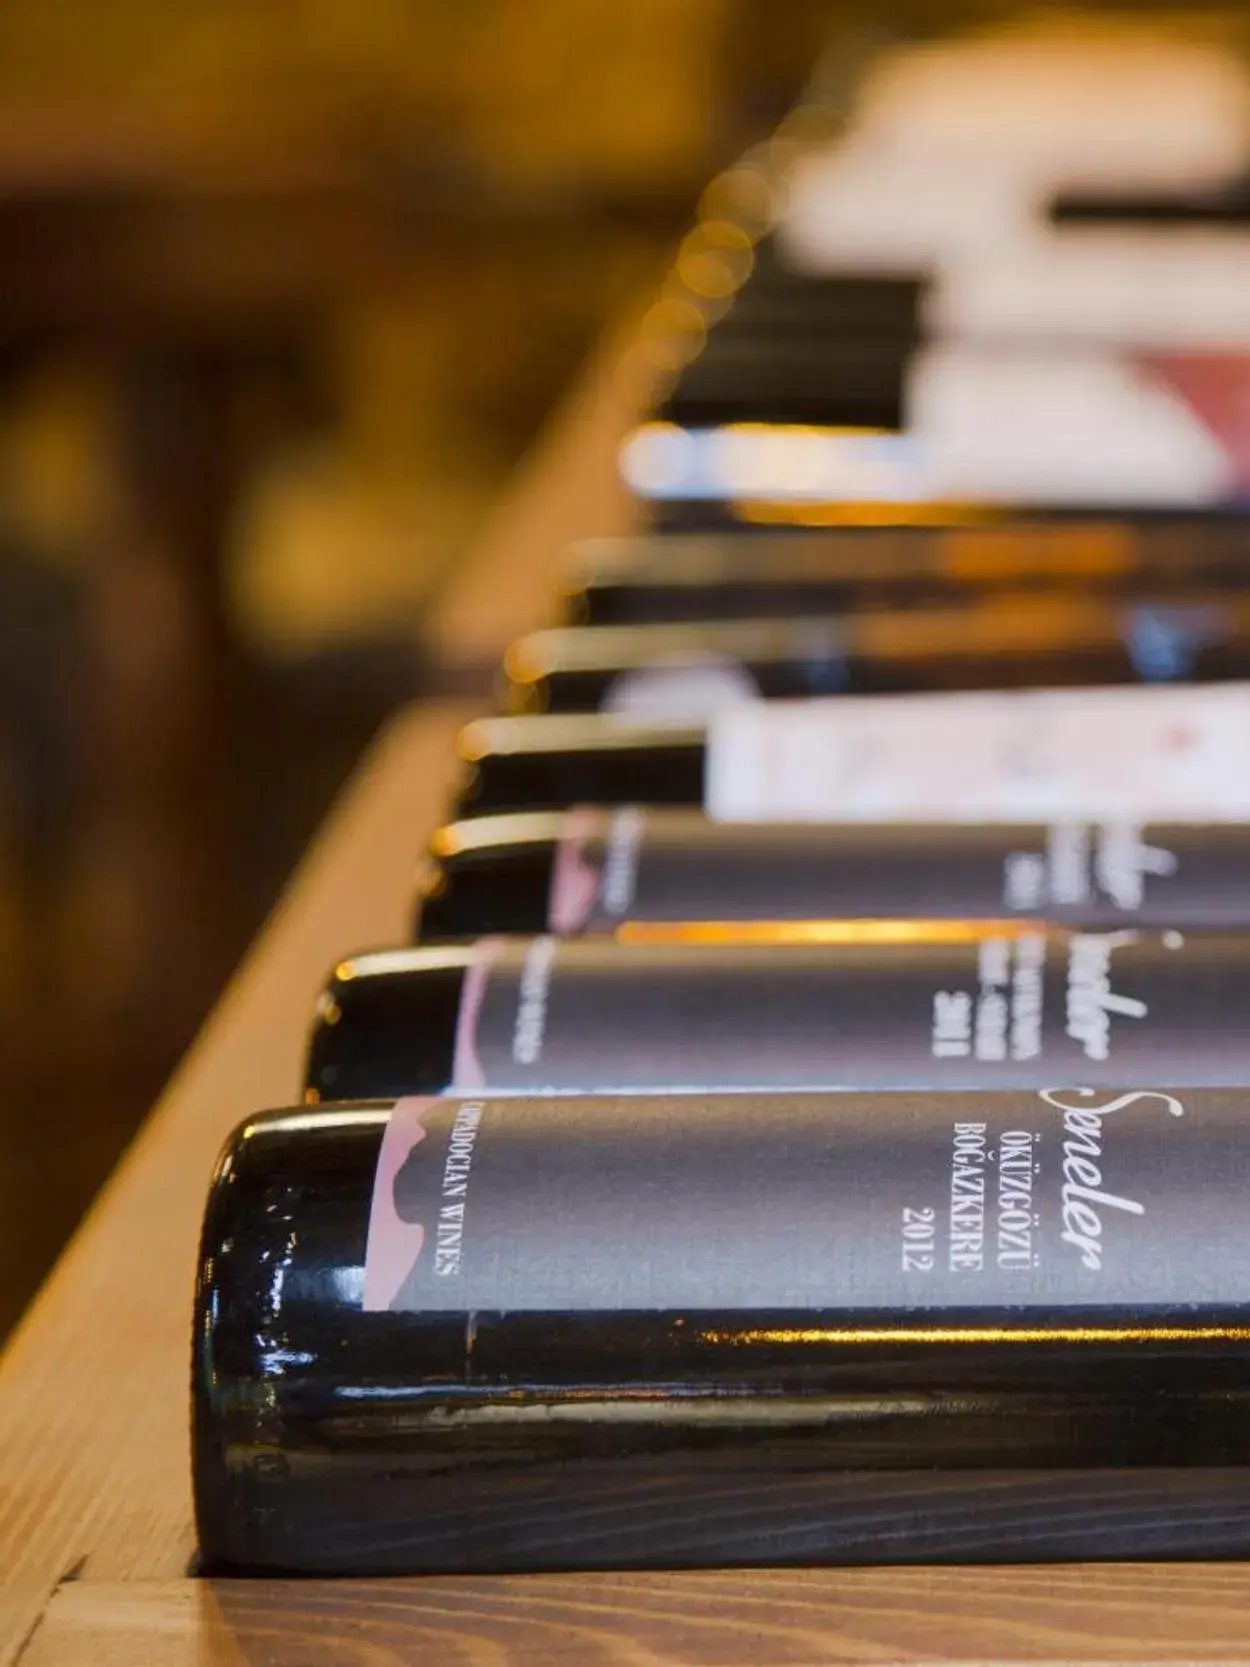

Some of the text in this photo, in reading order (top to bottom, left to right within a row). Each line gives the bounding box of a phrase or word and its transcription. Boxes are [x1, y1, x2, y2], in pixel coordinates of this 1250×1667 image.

[434, 1202, 466, 1276] WINES
[901, 1207, 935, 1272] 2012
[948, 1122, 998, 1272] BOĞAZKERE
[997, 1130, 1042, 1270] ÖKÜZGÖZÜ
[1039, 1086, 1184, 1270] Seneler
